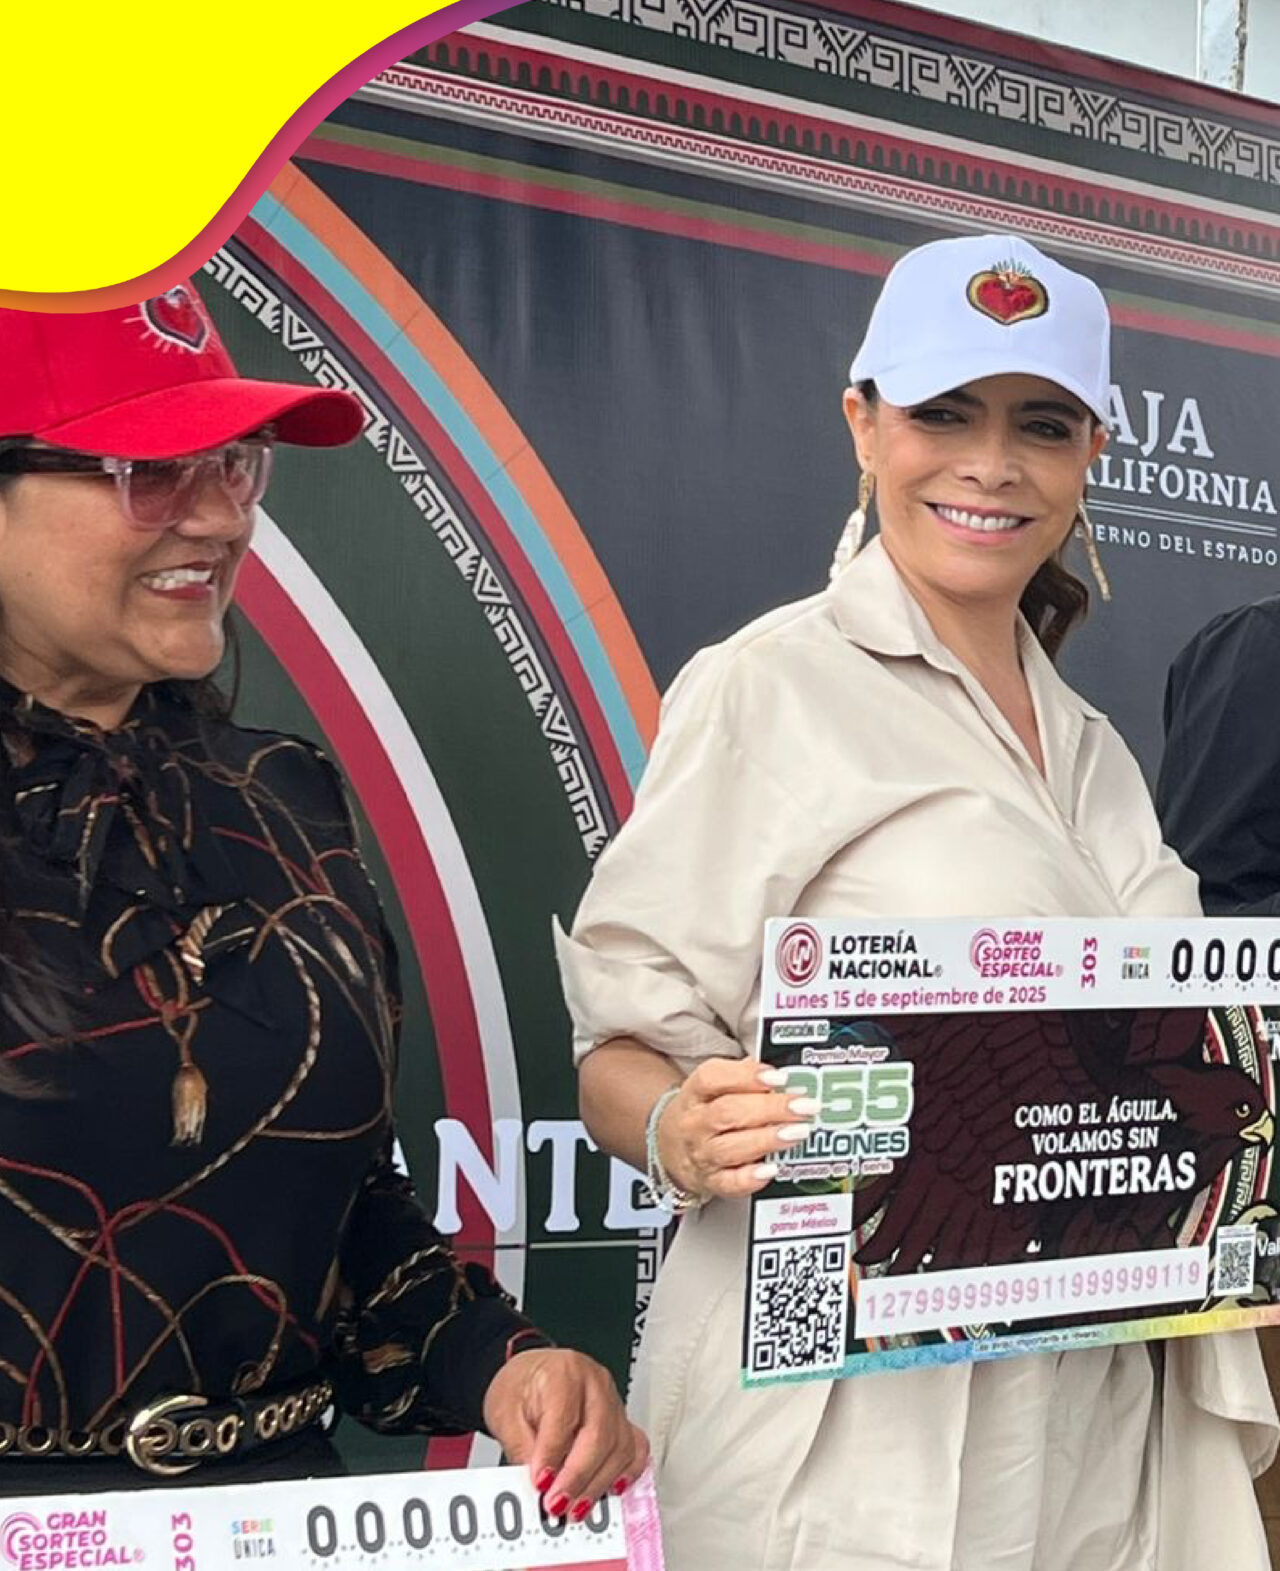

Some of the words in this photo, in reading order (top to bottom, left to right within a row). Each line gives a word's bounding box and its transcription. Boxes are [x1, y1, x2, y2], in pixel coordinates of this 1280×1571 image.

[1107, 384, 1214, 459] AJA
[1086, 454, 1278, 515] LIFORNIA
[1159, 534, 1196, 555] DEL
[1203, 539, 1278, 567] ESTADO
[829, 930, 918, 955] LOTERÍA
[1002, 931, 1044, 946] GRAN
[981, 946, 1042, 961] SORTEO
[1080, 936, 1098, 989] 303
[775, 990, 829, 1010] Lunes
[833, 990, 850, 1008] 15
[855, 988, 877, 1008] de
[880, 986, 978, 1010] septiembre
[982, 986, 1005, 1005] de
[1008, 986, 1047, 1004] 2025
[1014, 1103, 1073, 1128] COMO
[1078, 1102, 1101, 1125] EL
[1106, 1095, 1178, 1123] ÁGUILA,
[1032, 1127, 1123, 1155] VOLAMOS
[1127, 1126, 1160, 1149] SIN
[992, 1150, 1197, 1205] FRONTERAS
[46, 1511, 107, 1530] GRAN
[231, 1518, 274, 1535] SERIE
[18, 1529, 107, 1551] SORTEO
[233, 1537, 276, 1559] ÚNICA
